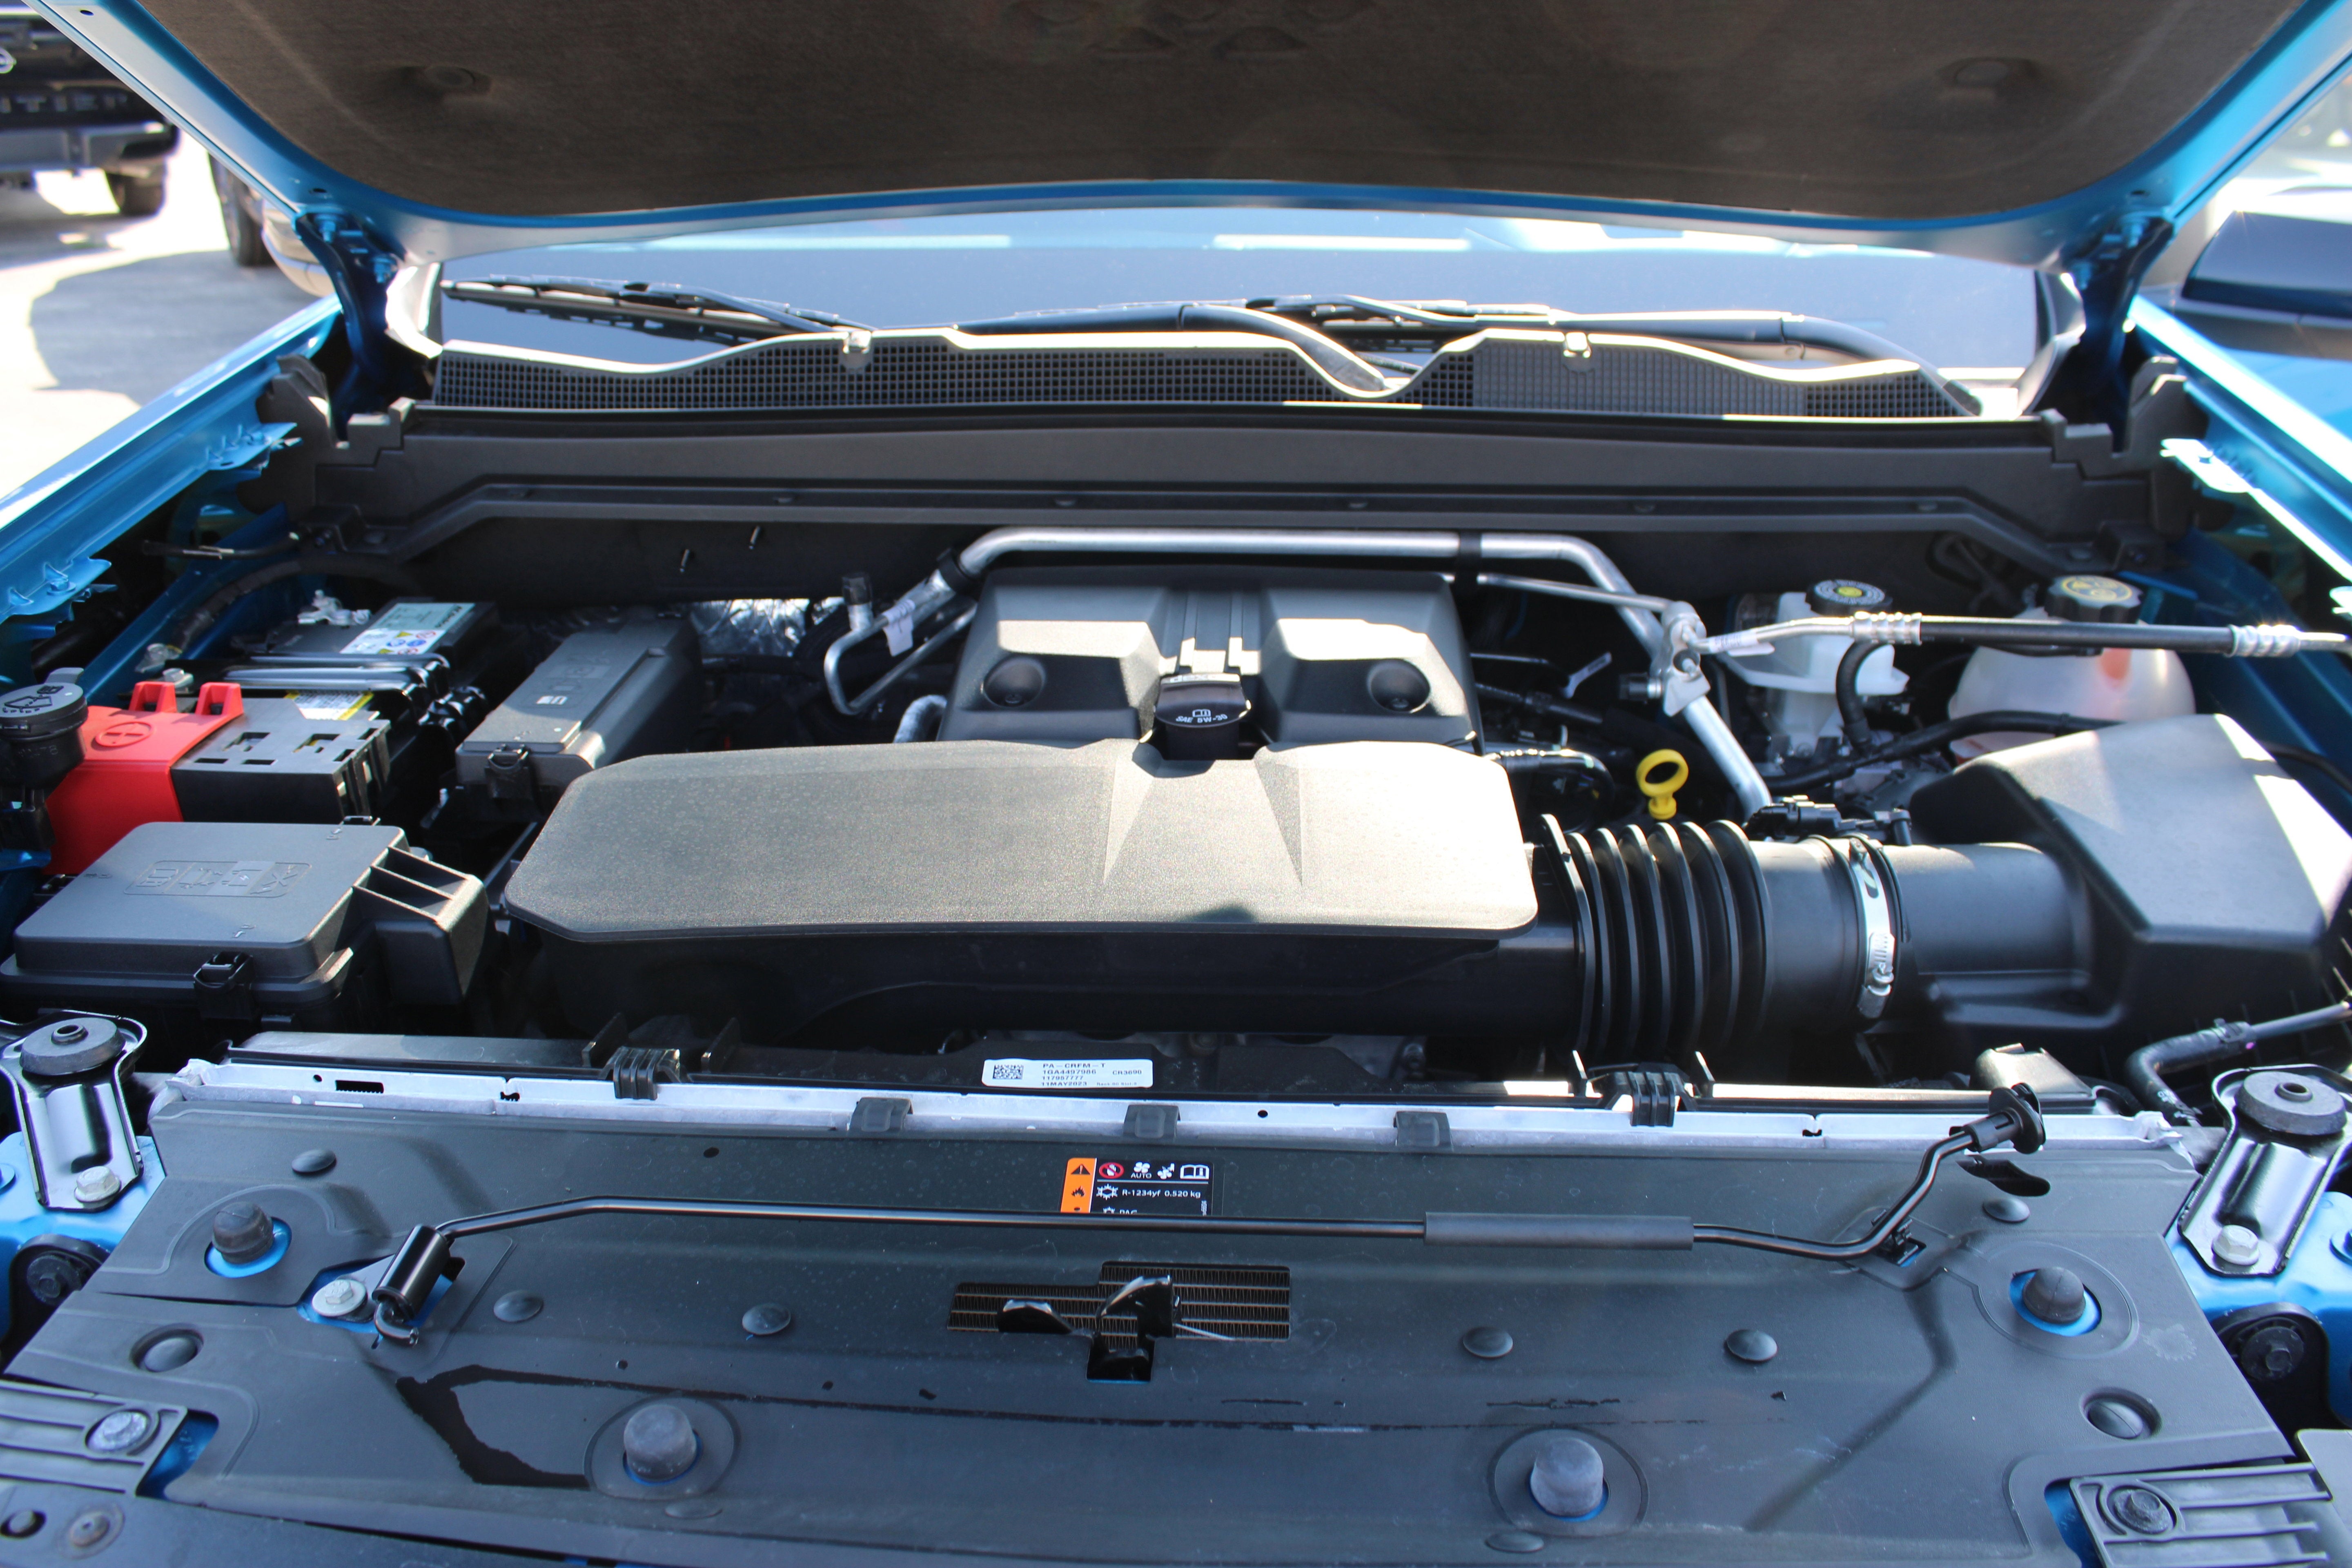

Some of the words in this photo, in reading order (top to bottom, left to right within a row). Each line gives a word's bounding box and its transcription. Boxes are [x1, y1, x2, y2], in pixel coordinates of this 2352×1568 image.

[1197, 714, 1228, 723] 5W-30
[1122, 1189, 1161, 1198] R-1234yf
[1190, 1190, 1201, 1198] kg
